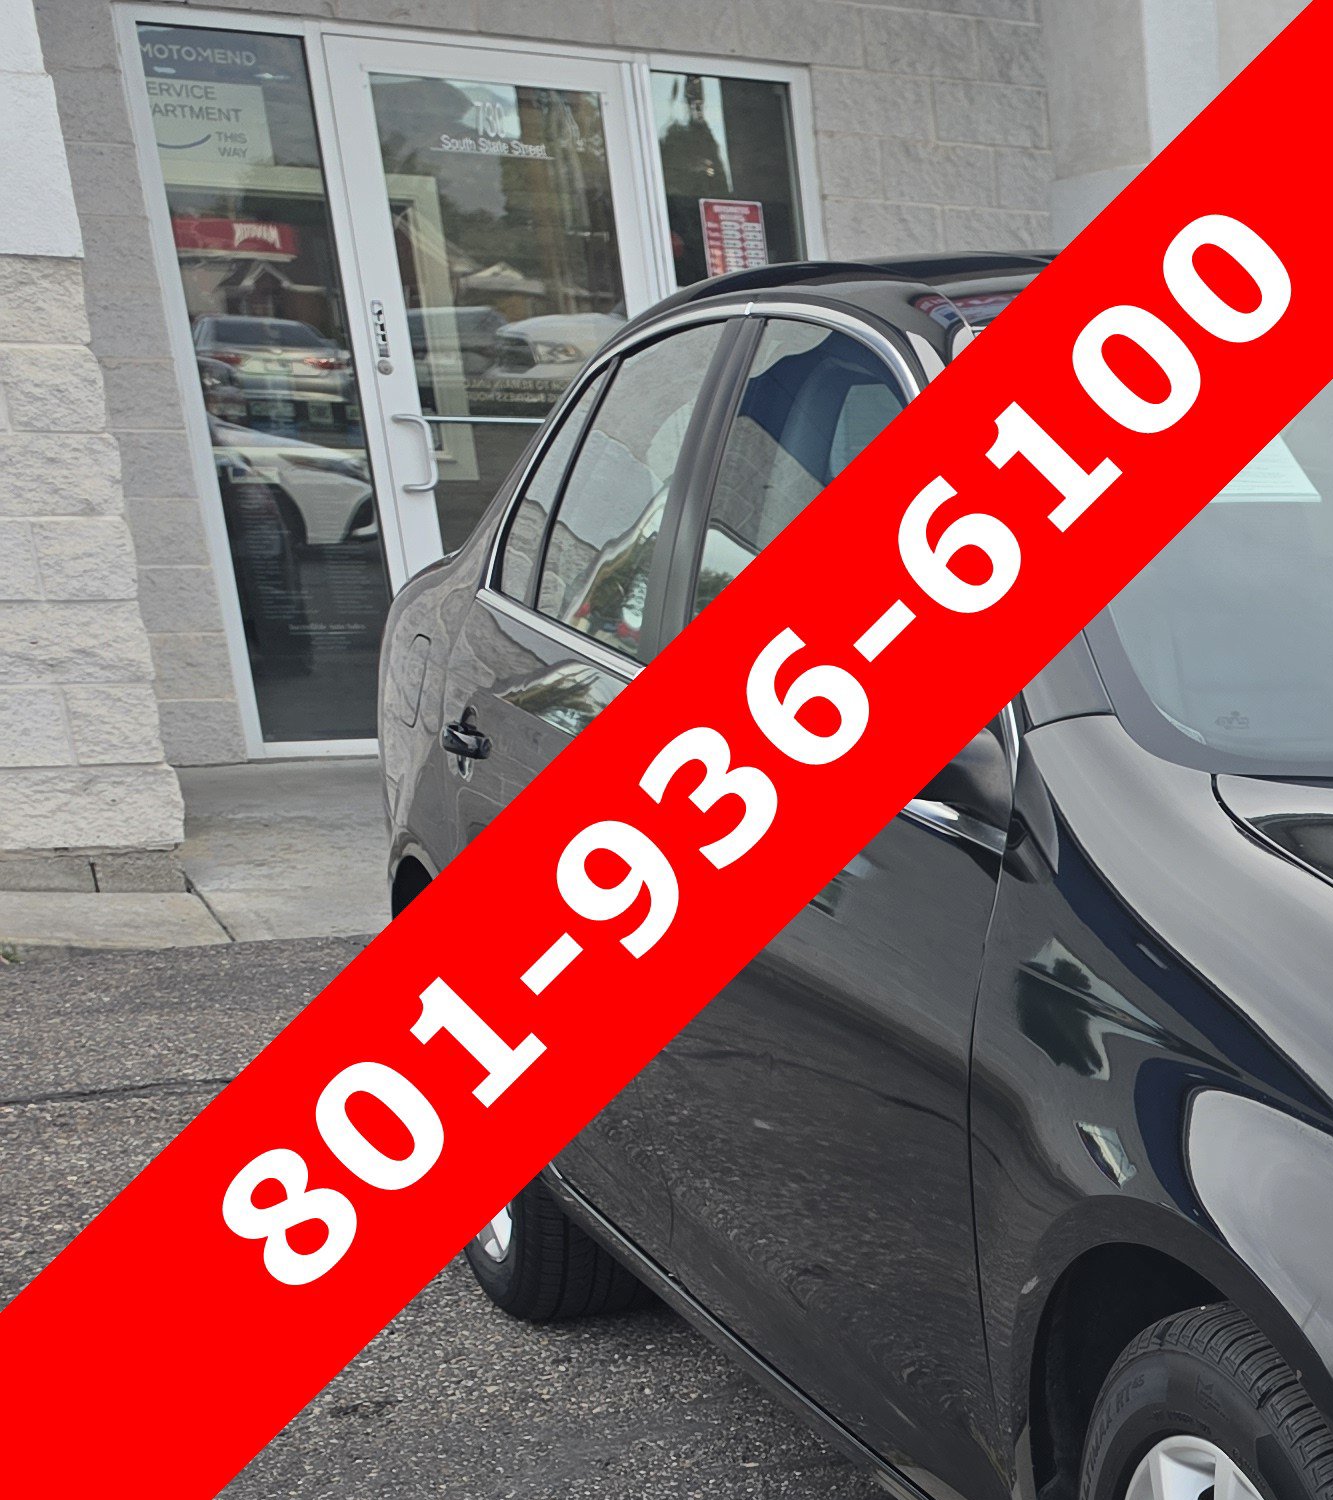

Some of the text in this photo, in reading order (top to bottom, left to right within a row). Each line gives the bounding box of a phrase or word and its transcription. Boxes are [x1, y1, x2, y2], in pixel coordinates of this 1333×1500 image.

[140, 43, 256, 66] MOTOMEND
[147, 81, 217, 100] ERVICE
[152, 102, 242, 122] ARTMENT
[215, 131, 248, 144] THIS
[439, 134, 547, 156] South State Street
[218, 147, 248, 159] WAY
